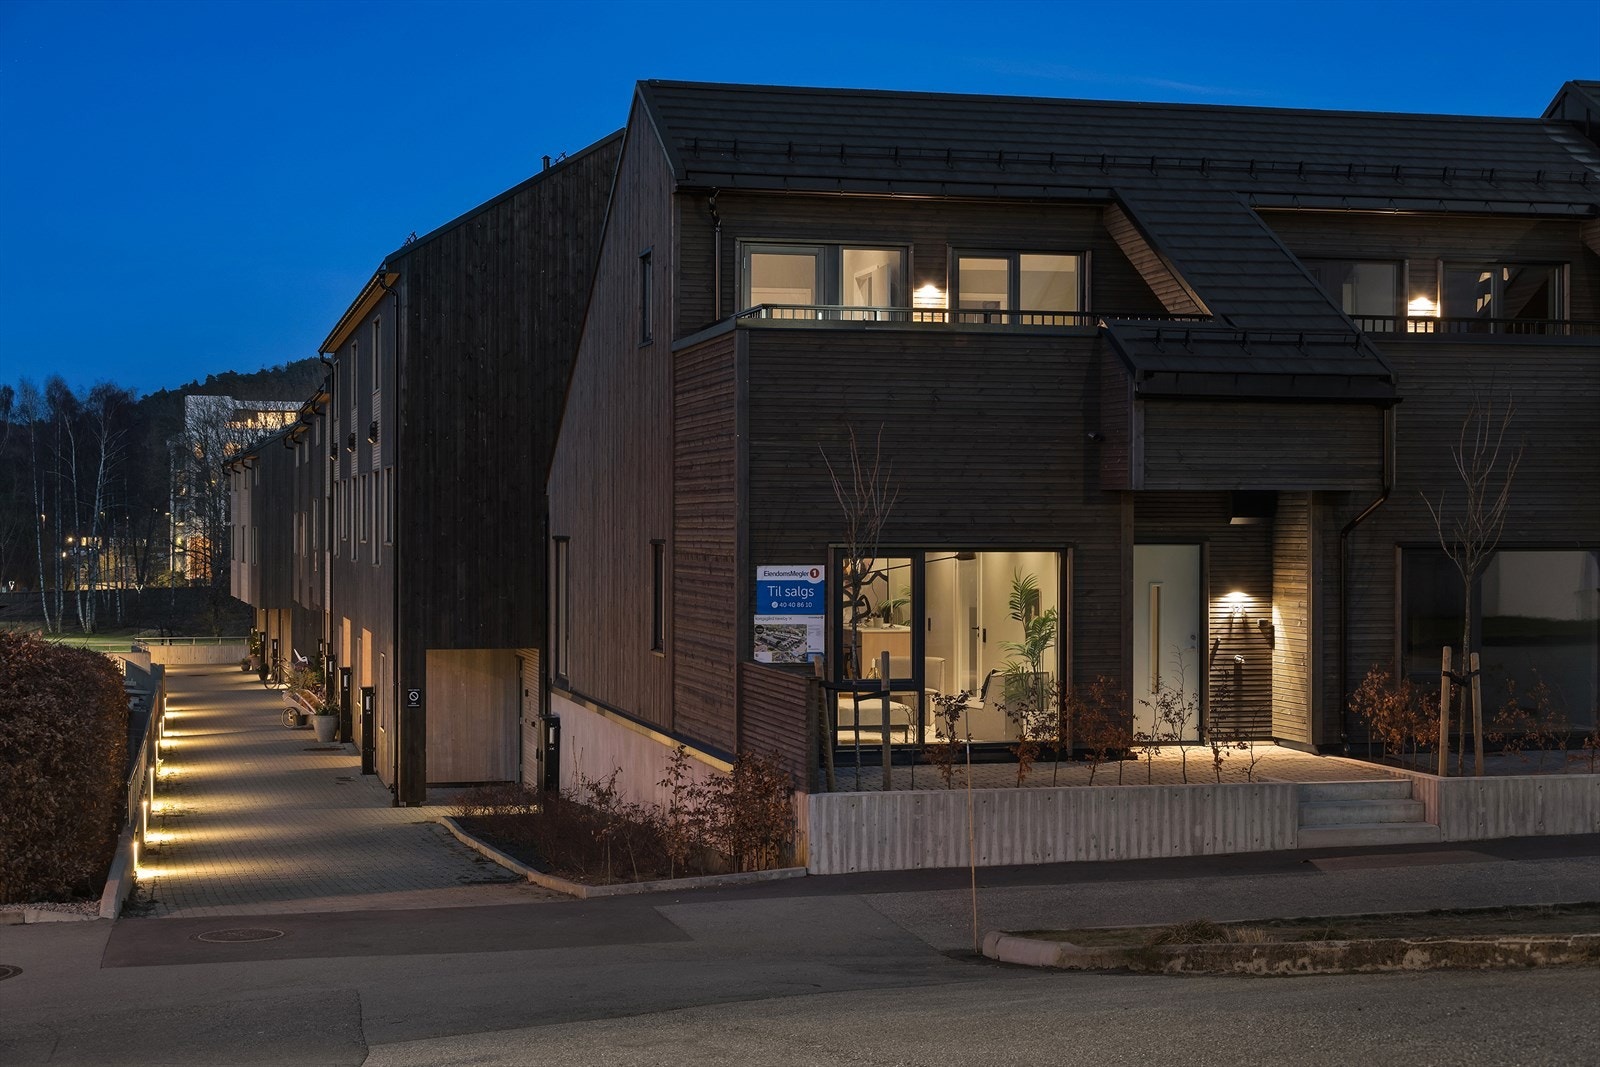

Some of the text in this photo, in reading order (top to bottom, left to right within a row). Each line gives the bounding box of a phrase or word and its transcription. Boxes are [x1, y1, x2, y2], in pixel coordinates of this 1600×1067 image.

[764, 570, 809, 578] EiendomsMegler
[767, 585, 815, 600] Til salgs
